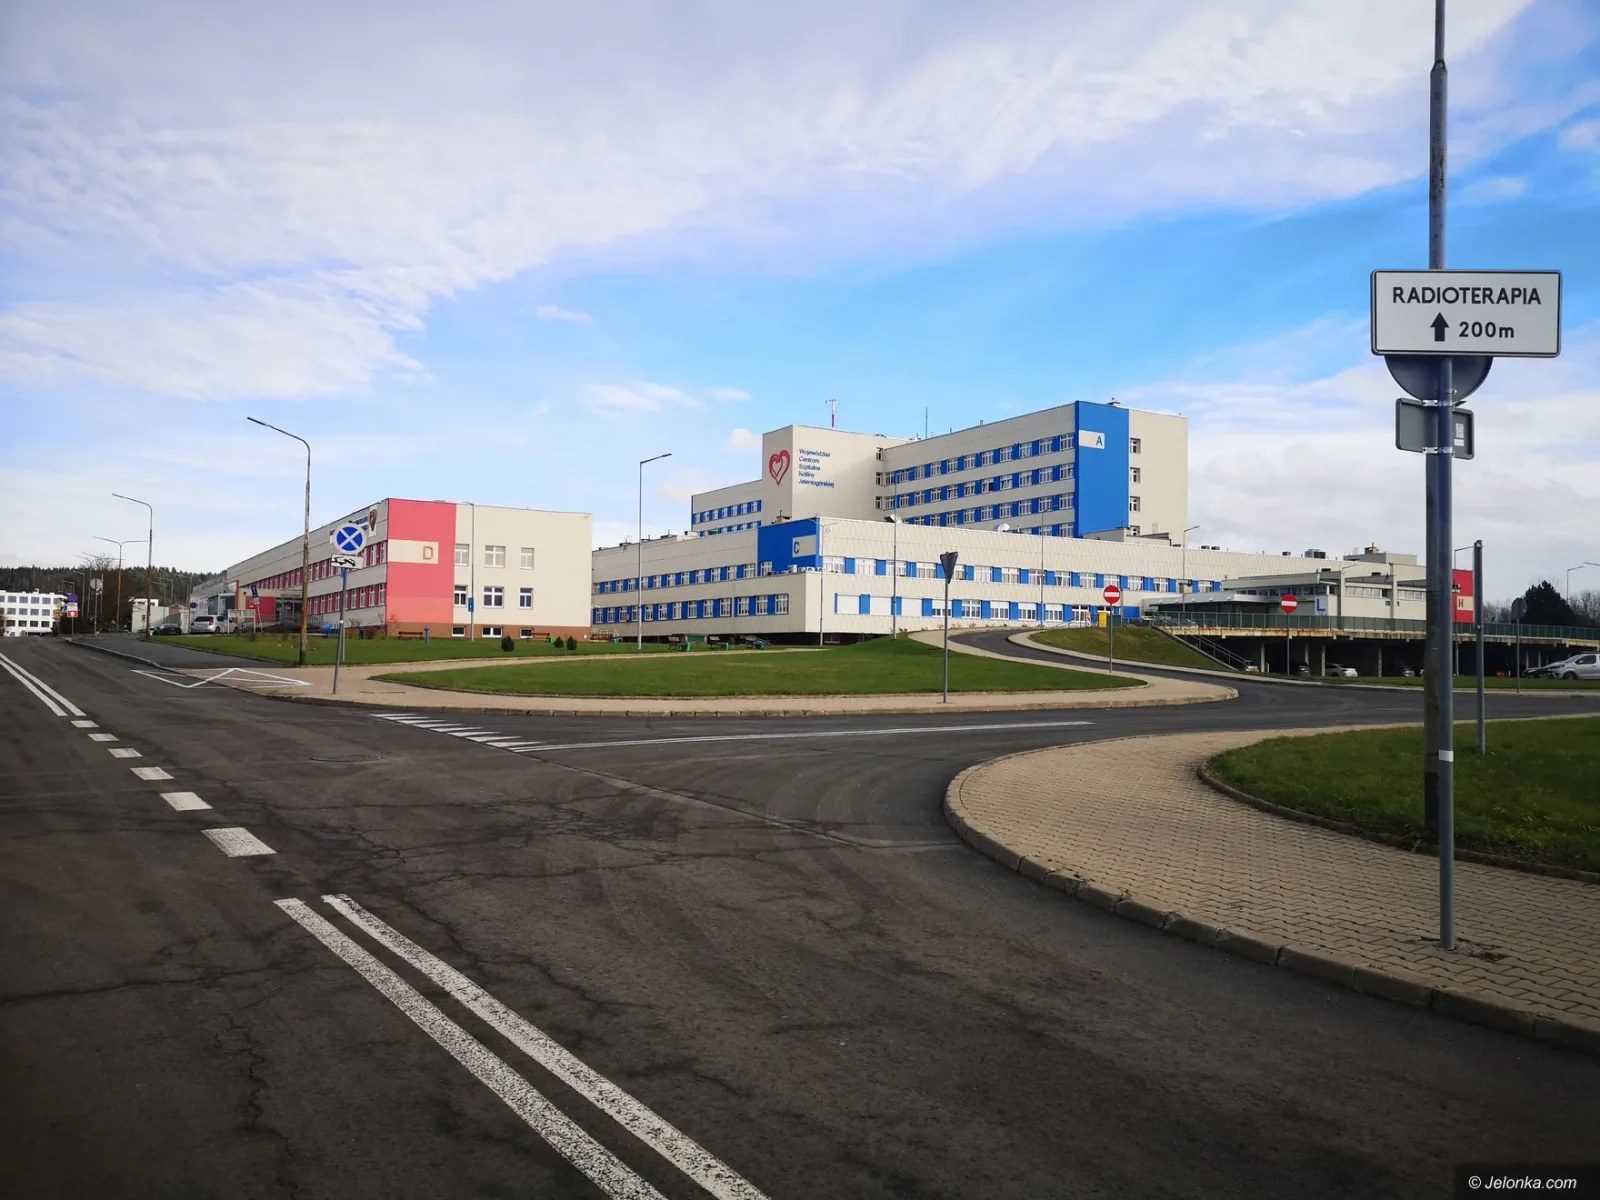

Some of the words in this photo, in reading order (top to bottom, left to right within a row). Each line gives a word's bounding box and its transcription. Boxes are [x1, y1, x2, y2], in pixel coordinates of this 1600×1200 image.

[1393, 287, 1542, 305] RADIOTERAPIA
[1459, 322, 1514, 338] 200m
[1096, 435, 1103, 446] A
[799, 456, 820, 464] Centrum
[423, 546, 434, 560] D
[794, 541, 800, 554] C
[1317, 598, 1325, 611] L
[1458, 598, 1464, 608] H
